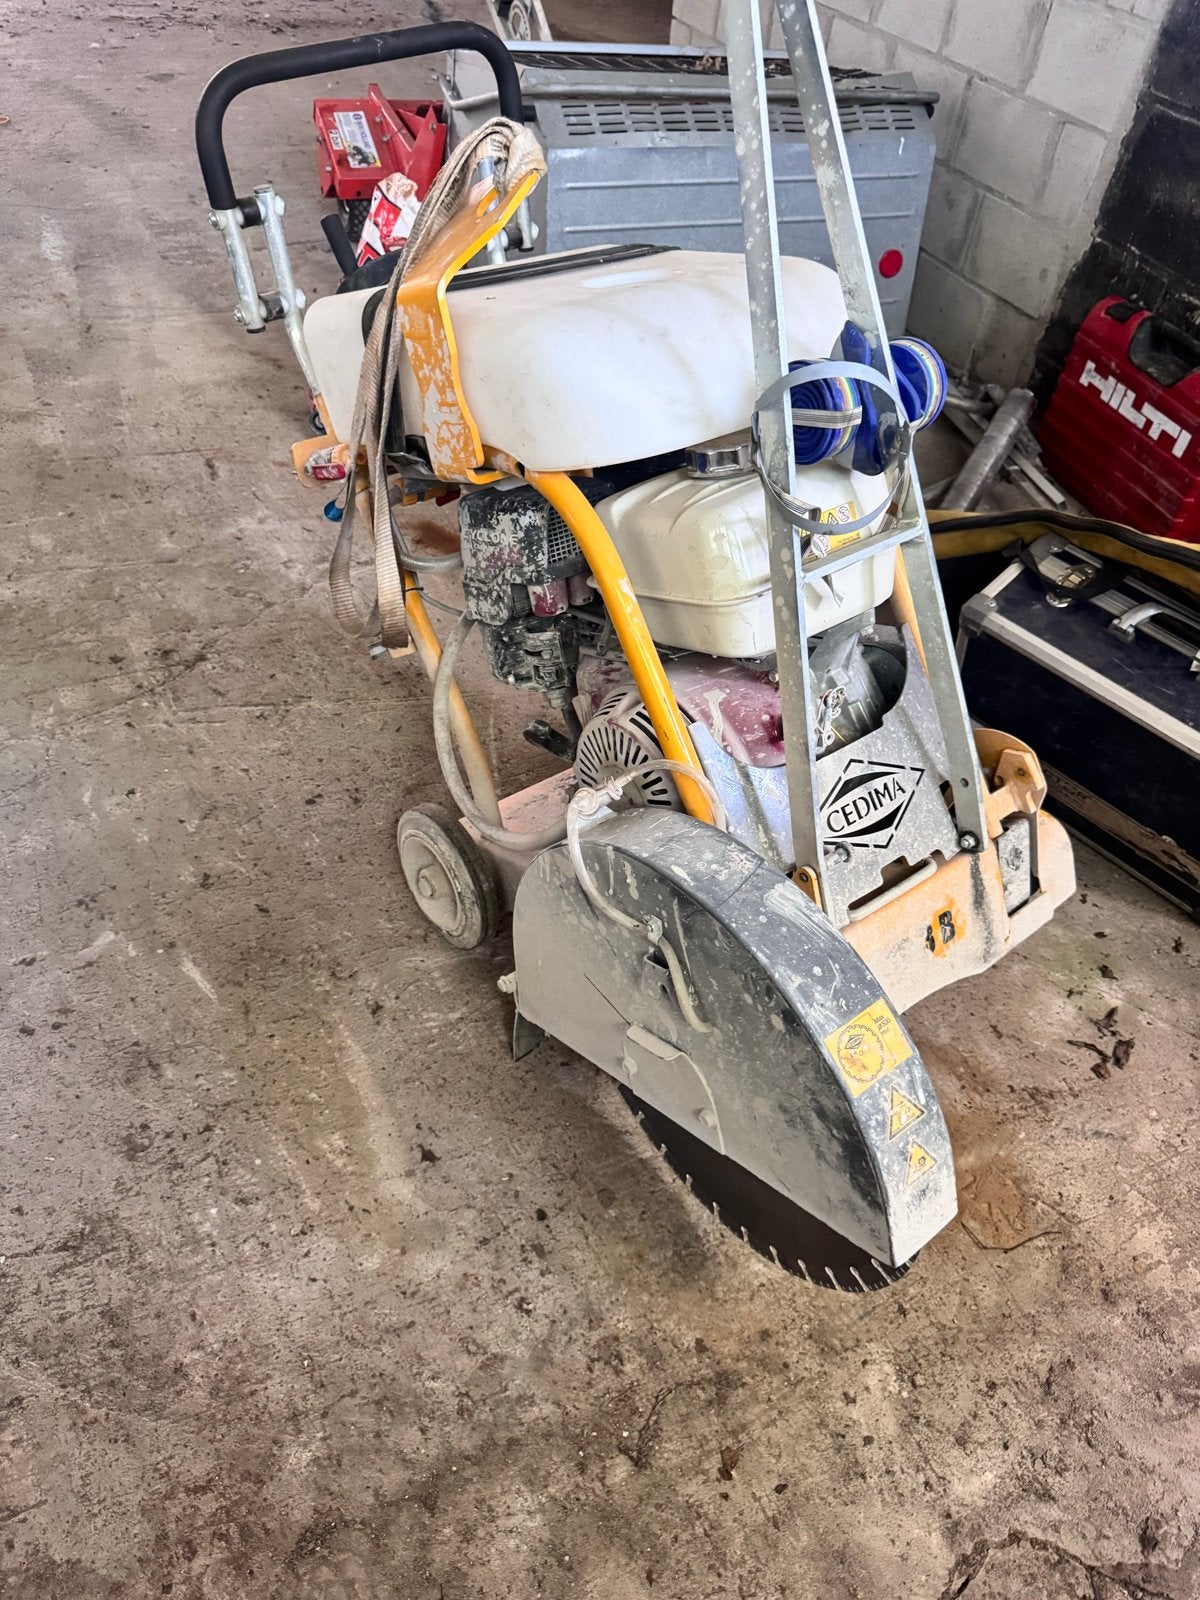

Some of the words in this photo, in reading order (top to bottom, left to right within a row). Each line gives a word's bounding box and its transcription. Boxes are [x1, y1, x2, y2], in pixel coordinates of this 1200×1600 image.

[331, 136, 341, 149] bar
[1079, 359, 1192, 459] HILTI
[463, 528, 519, 547] CYCLONE
[826, 777, 906, 833] CEDIMA
